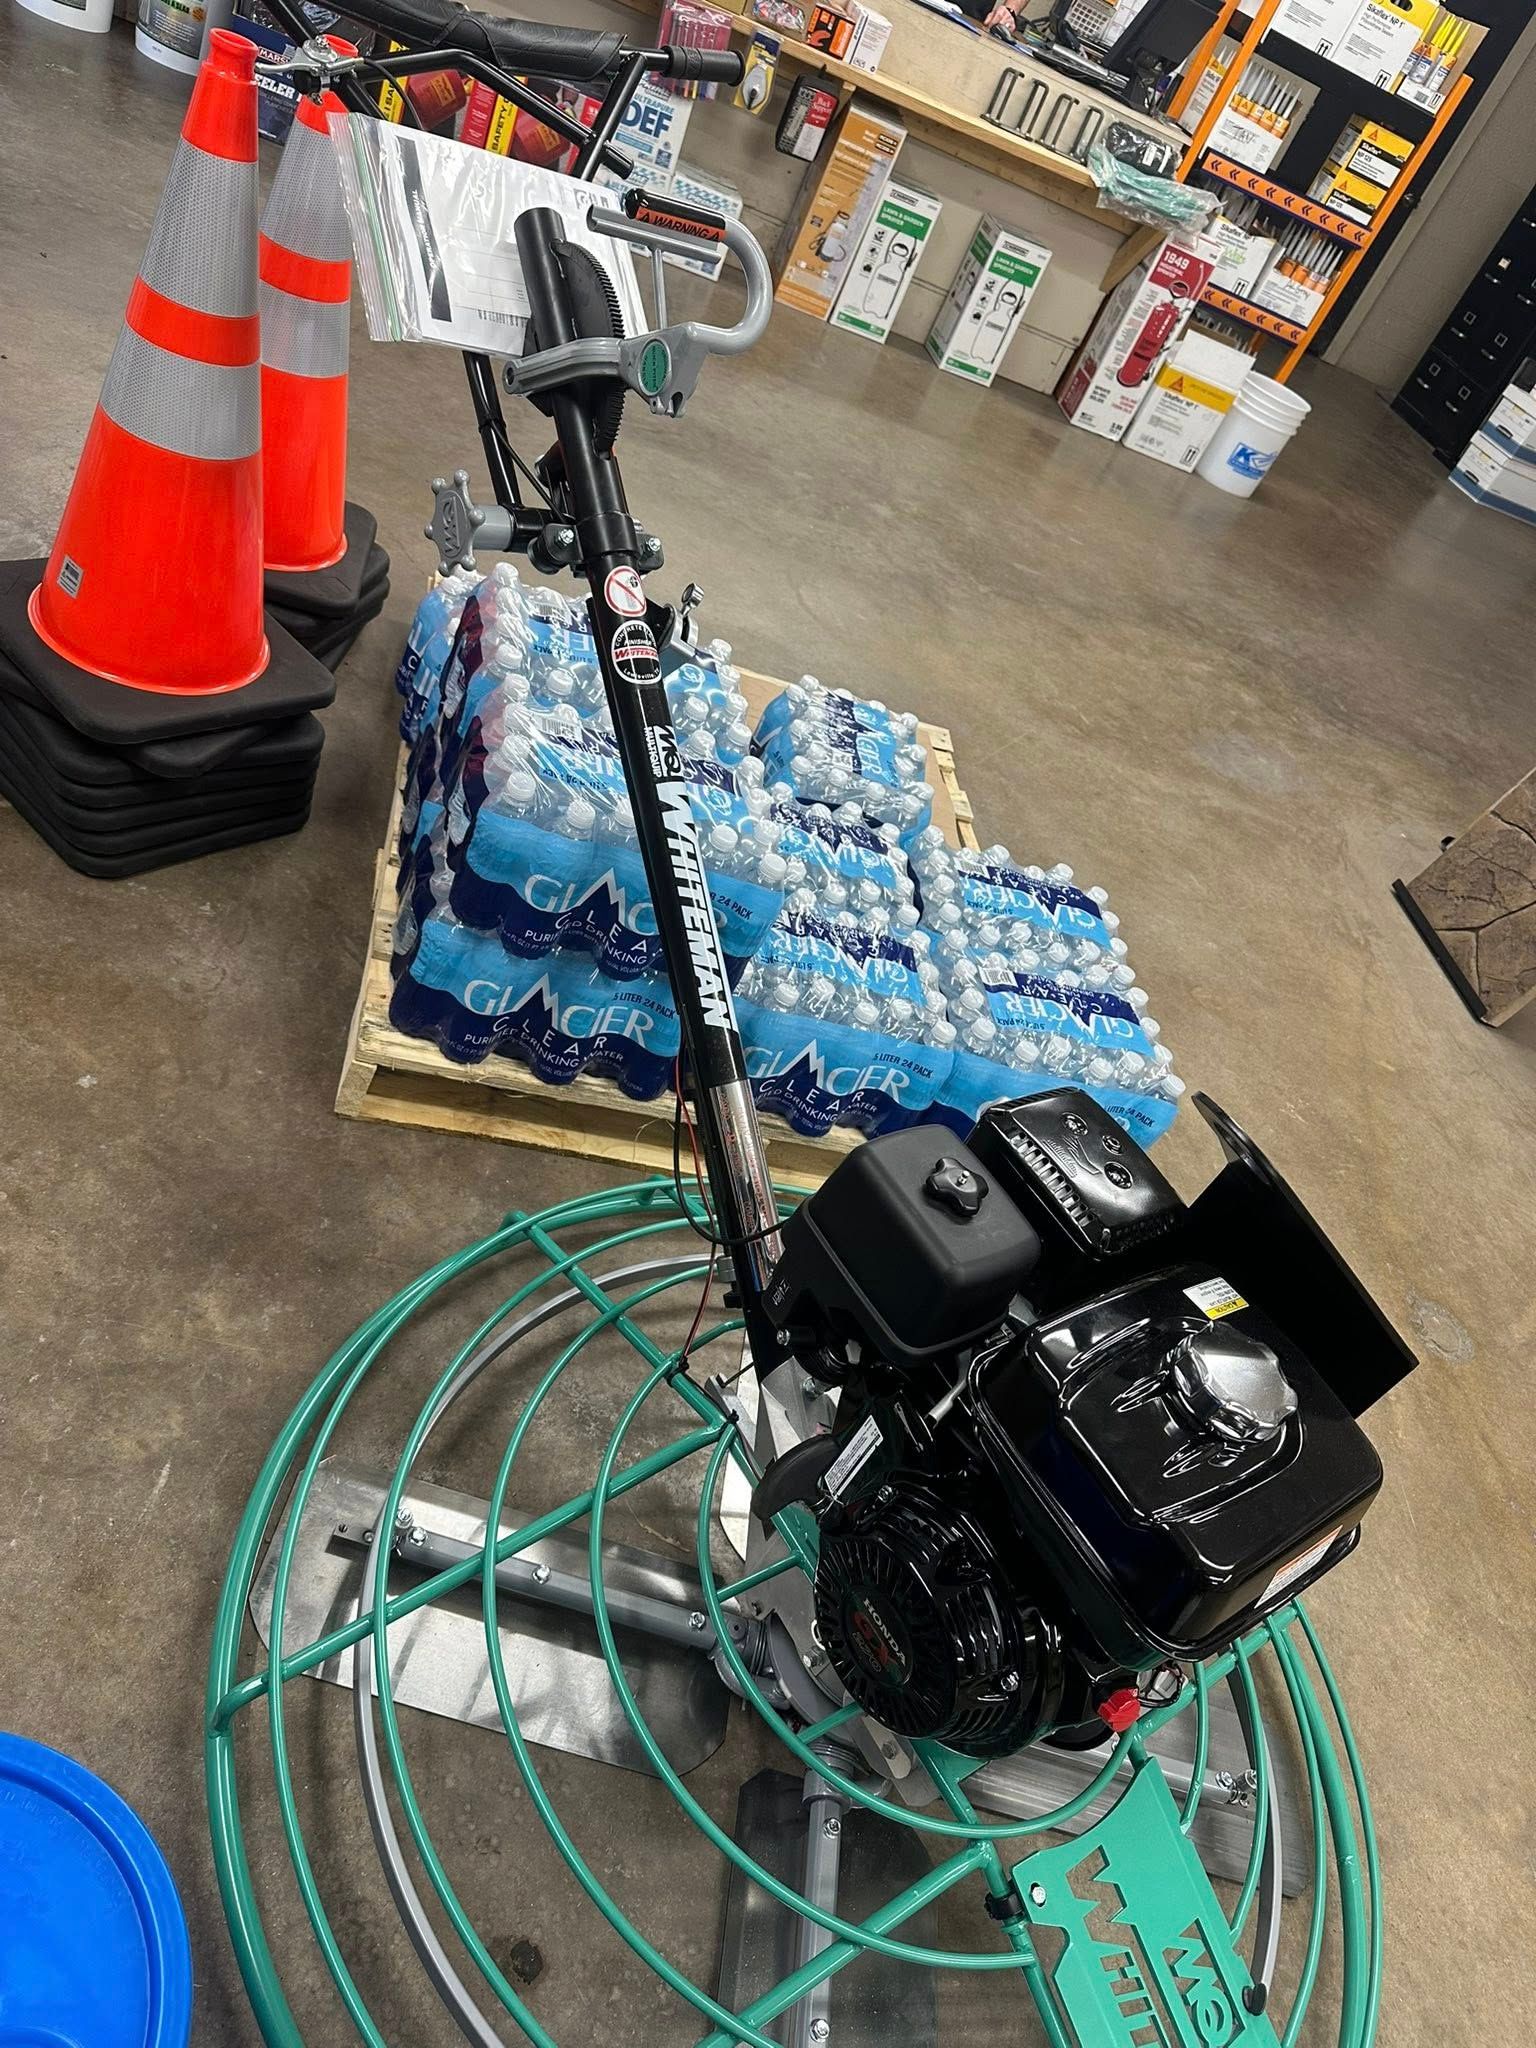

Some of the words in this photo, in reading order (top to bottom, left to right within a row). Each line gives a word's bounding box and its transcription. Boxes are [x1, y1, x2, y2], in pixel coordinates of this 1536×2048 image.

[621, 100, 673, 138] DEF
[654, 216, 709, 239] WARNING
[1163, 250, 1190, 270] 1949
[643, 726, 662, 778] MULTIQUIP
[656, 780, 732, 1031] WHITEMAN
[731, 901, 753, 920] PACK
[555, 910, 647, 953] CLEA
[464, 972, 655, 1048] GLACIER
[620, 992, 642, 1005] LITER
[641, 998, 655, 1009] 24
[655, 1001, 677, 1020] PACK
[1004, 992, 1134, 1039] GLACIER
[493, 1016, 608, 1056] CLEAR
[520, 1032, 580, 1068] DRINKING
[744, 1038, 910, 1104] GLACIER
[879, 1053, 901, 1065] LITER
[901, 1059, 914, 1070] 24
[914, 1064, 935, 1079] PACK
[759, 1079, 865, 1112] CLEAR
[1135, 1111, 1156, 1128] PACK
[862, 1597, 907, 1668] HONDA
